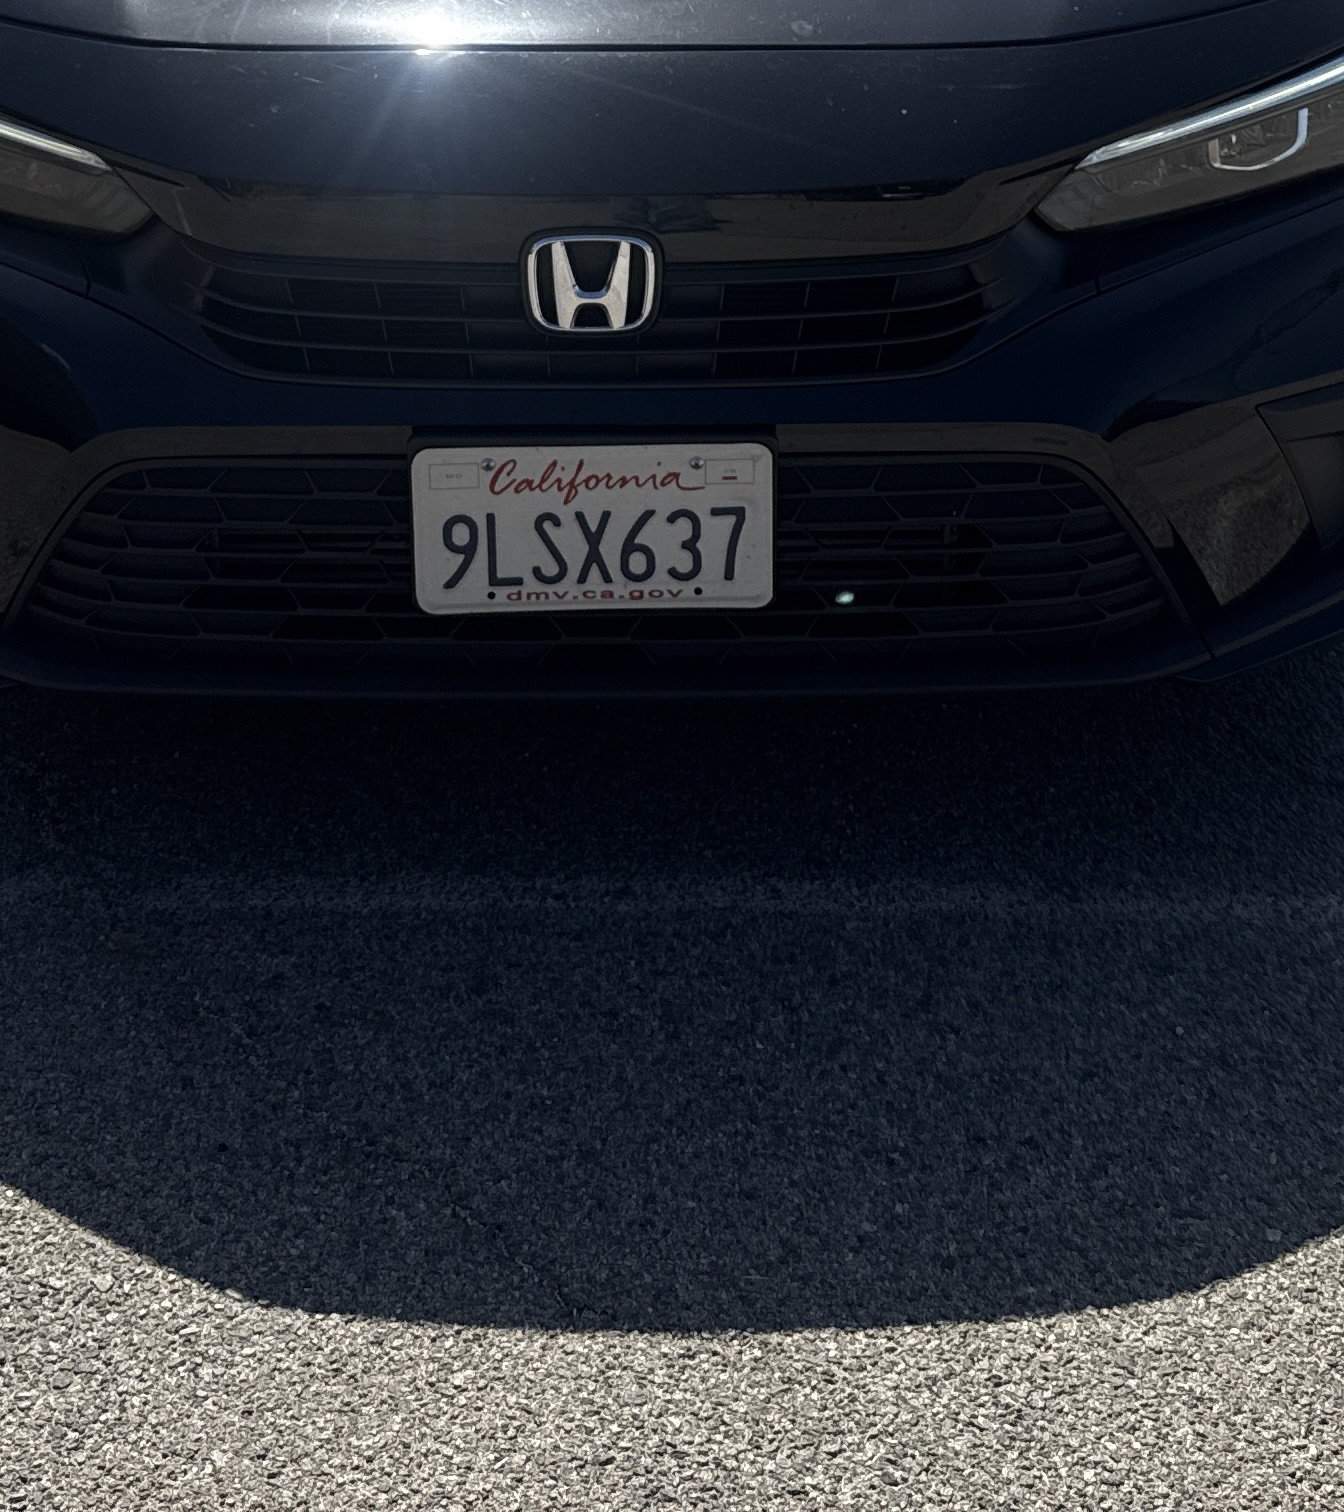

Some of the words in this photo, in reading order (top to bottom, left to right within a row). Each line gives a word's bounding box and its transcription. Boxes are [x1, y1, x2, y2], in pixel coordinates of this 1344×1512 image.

[489, 459, 705, 505] California
[442, 506, 746, 589] 9LSX637
[506, 588, 683, 602] dmv.ca.gov
